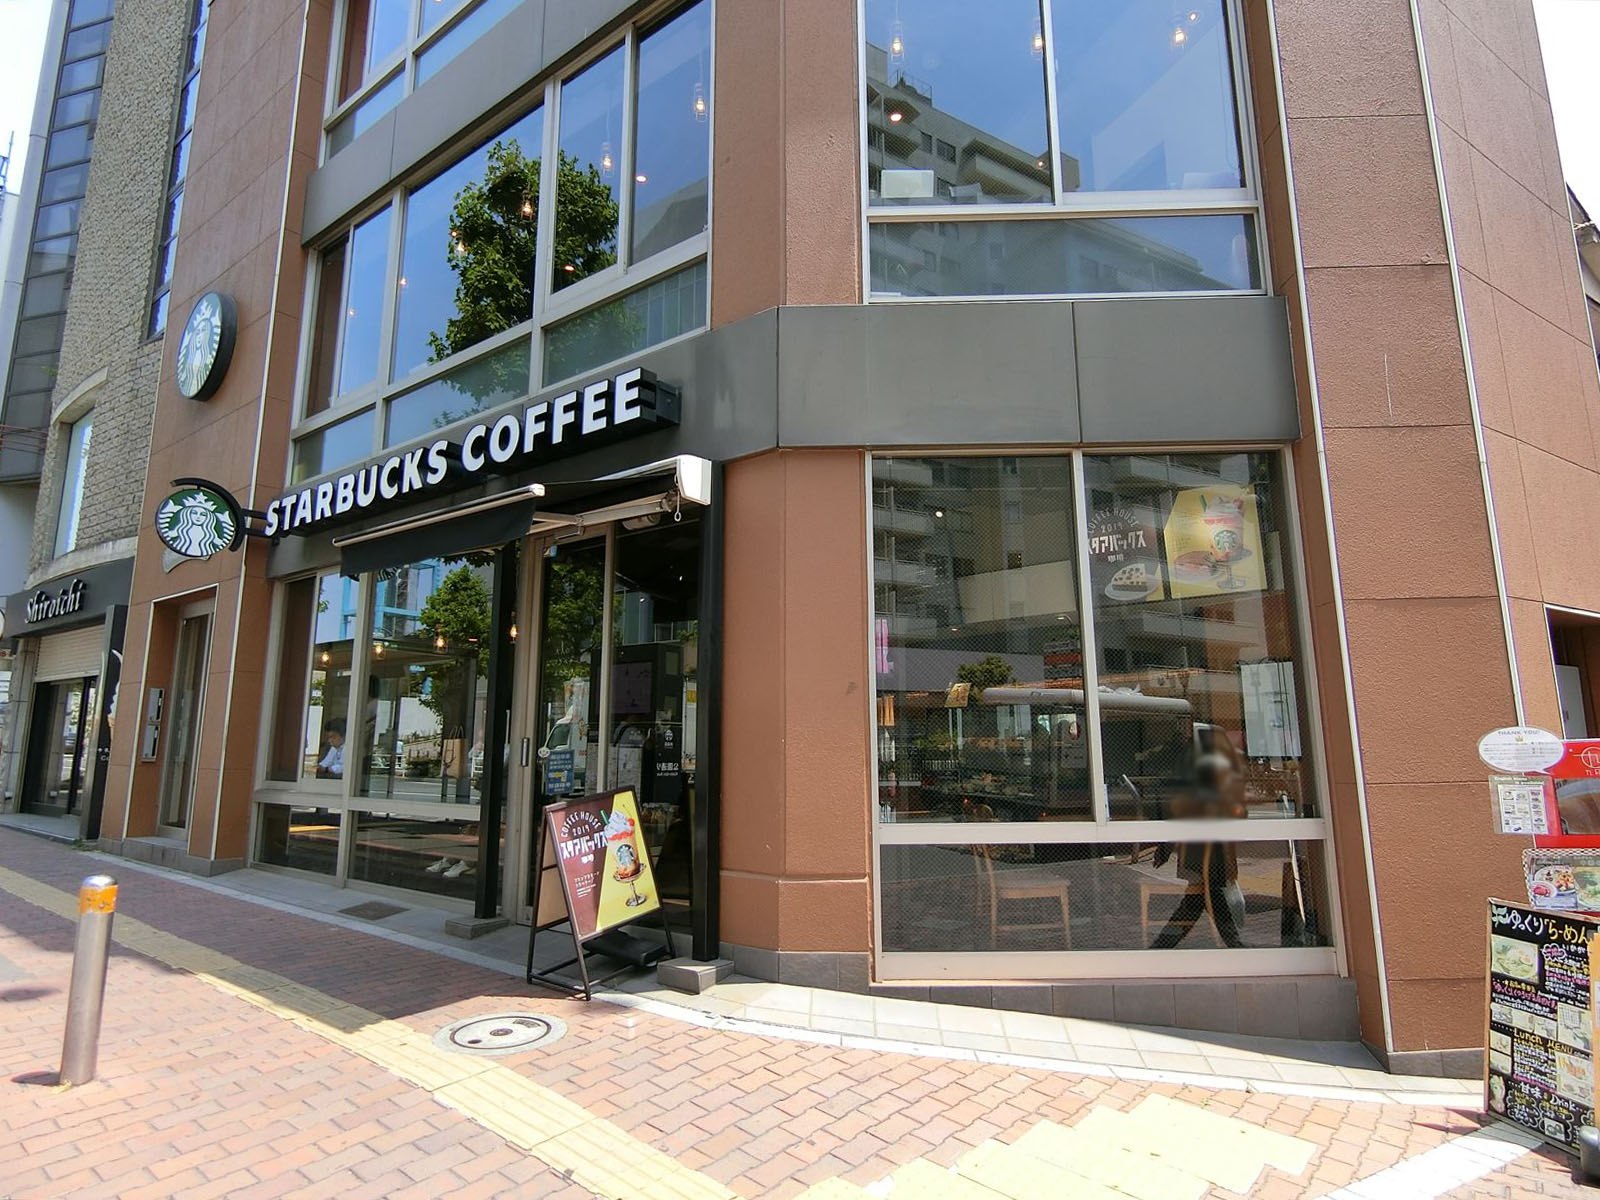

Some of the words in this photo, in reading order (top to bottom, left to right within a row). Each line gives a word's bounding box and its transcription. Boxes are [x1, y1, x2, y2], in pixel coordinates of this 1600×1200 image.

[264, 439, 449, 537] STARBUCKS
[461, 367, 642, 472] COFFEE
[1113, 507, 1140, 528] HOUSE
[25, 578, 83, 624] Shiroichi
[561, 812, 579, 838] COFFEE
[580, 811, 602, 829] HOUSE
[572, 824, 590, 836] 2019
[1514, 1027, 1543, 1045] Lunch
[1547, 1039, 1573, 1054] MENU
[1550, 1093, 1576, 1111] Drink
